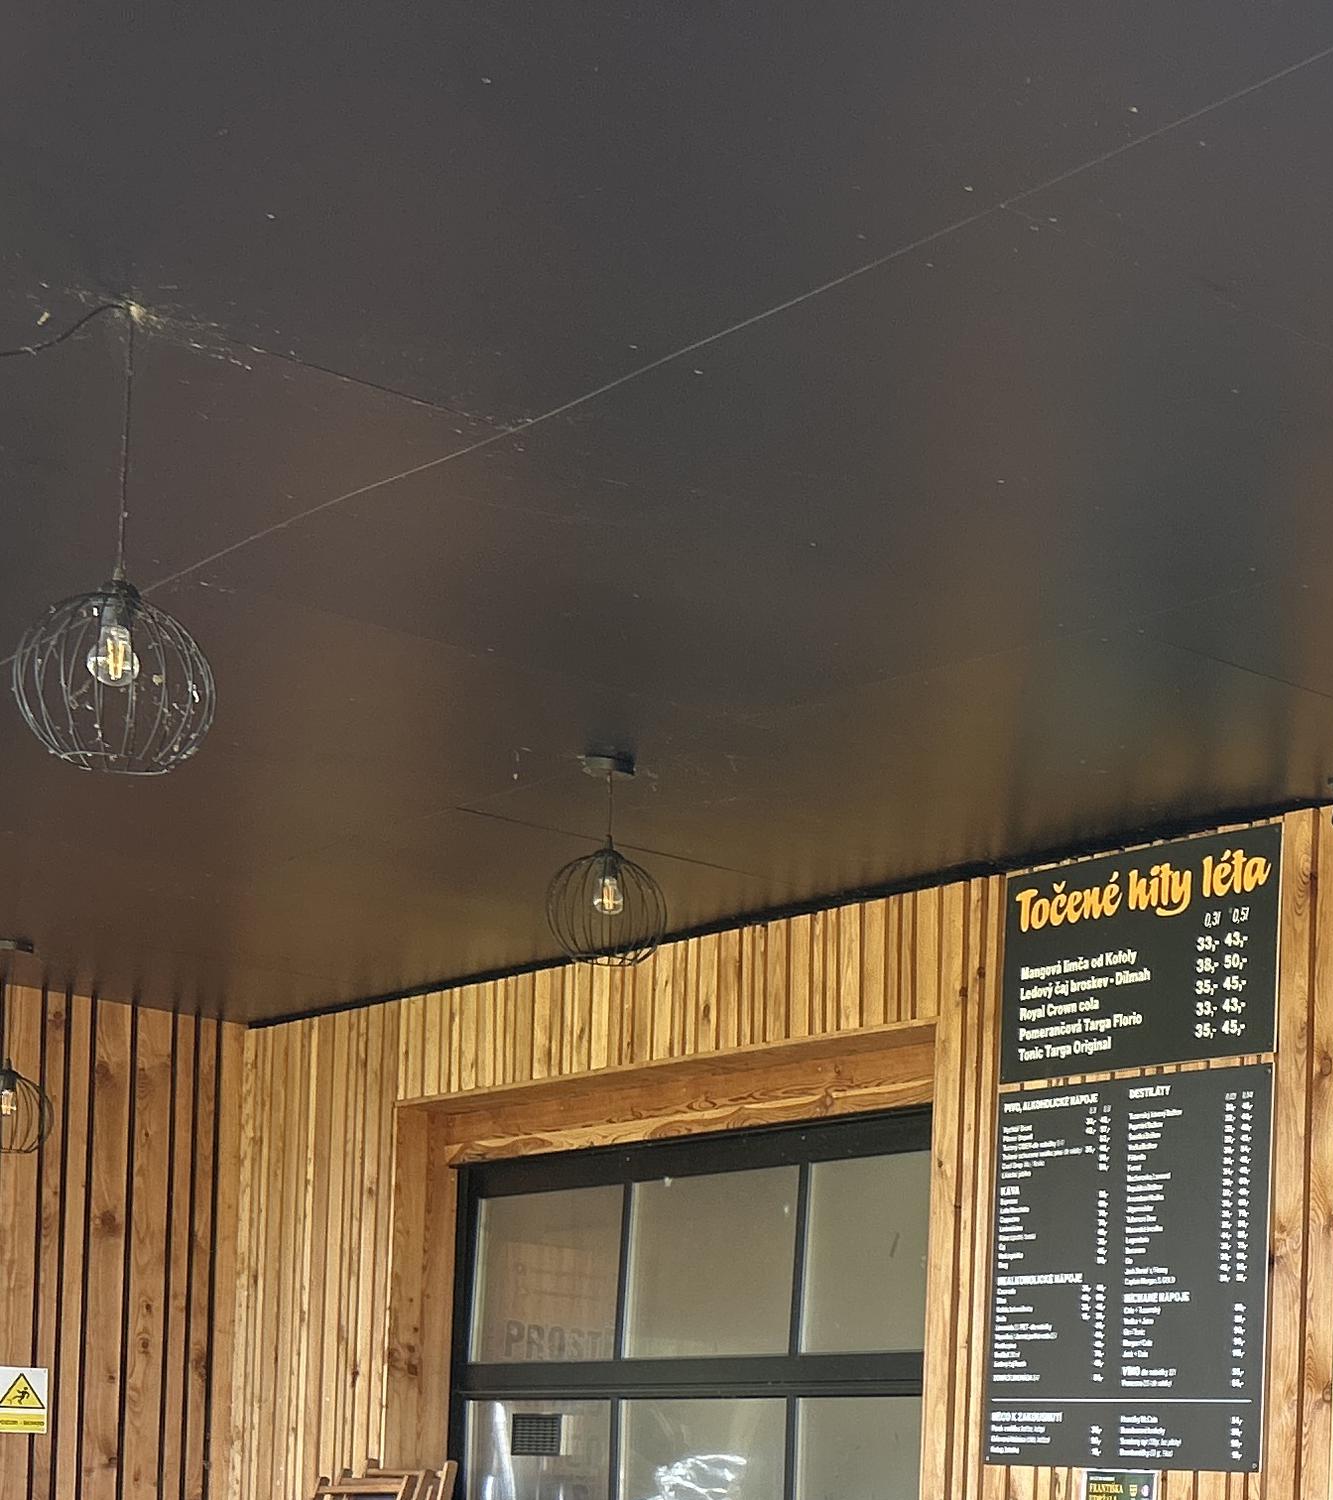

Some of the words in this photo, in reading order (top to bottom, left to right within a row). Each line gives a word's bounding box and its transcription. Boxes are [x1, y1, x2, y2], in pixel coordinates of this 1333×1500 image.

[1015, 871, 1123, 932] Točené
[1128, 862, 1192, 917] hity
[1202, 849, 1272, 898] léta
[1091, 953, 1104, 968] od
[1105, 949, 1137, 966] Kofoly
[1020, 982, 1054, 1001] Ledový
[1054, 980, 1069, 996] čaj
[1070, 976, 1109, 993] broskev
[1115, 967, 1151, 985] Dilmah
[1019, 1005, 1046, 1021] Royal
[1046, 1002, 1077, 1017] Crown
[1078, 997, 1100, 1012] cola
[1018, 1019, 1082, 1041] Pomerančová
[1083, 1017, 1112, 1032] Targa
[1112, 1012, 1143, 1028] Florio
[1018, 1046, 1044, 1062] Tonic
[1044, 1044, 1072, 1059] Targa
[1072, 1036, 1112, 1055] Original
